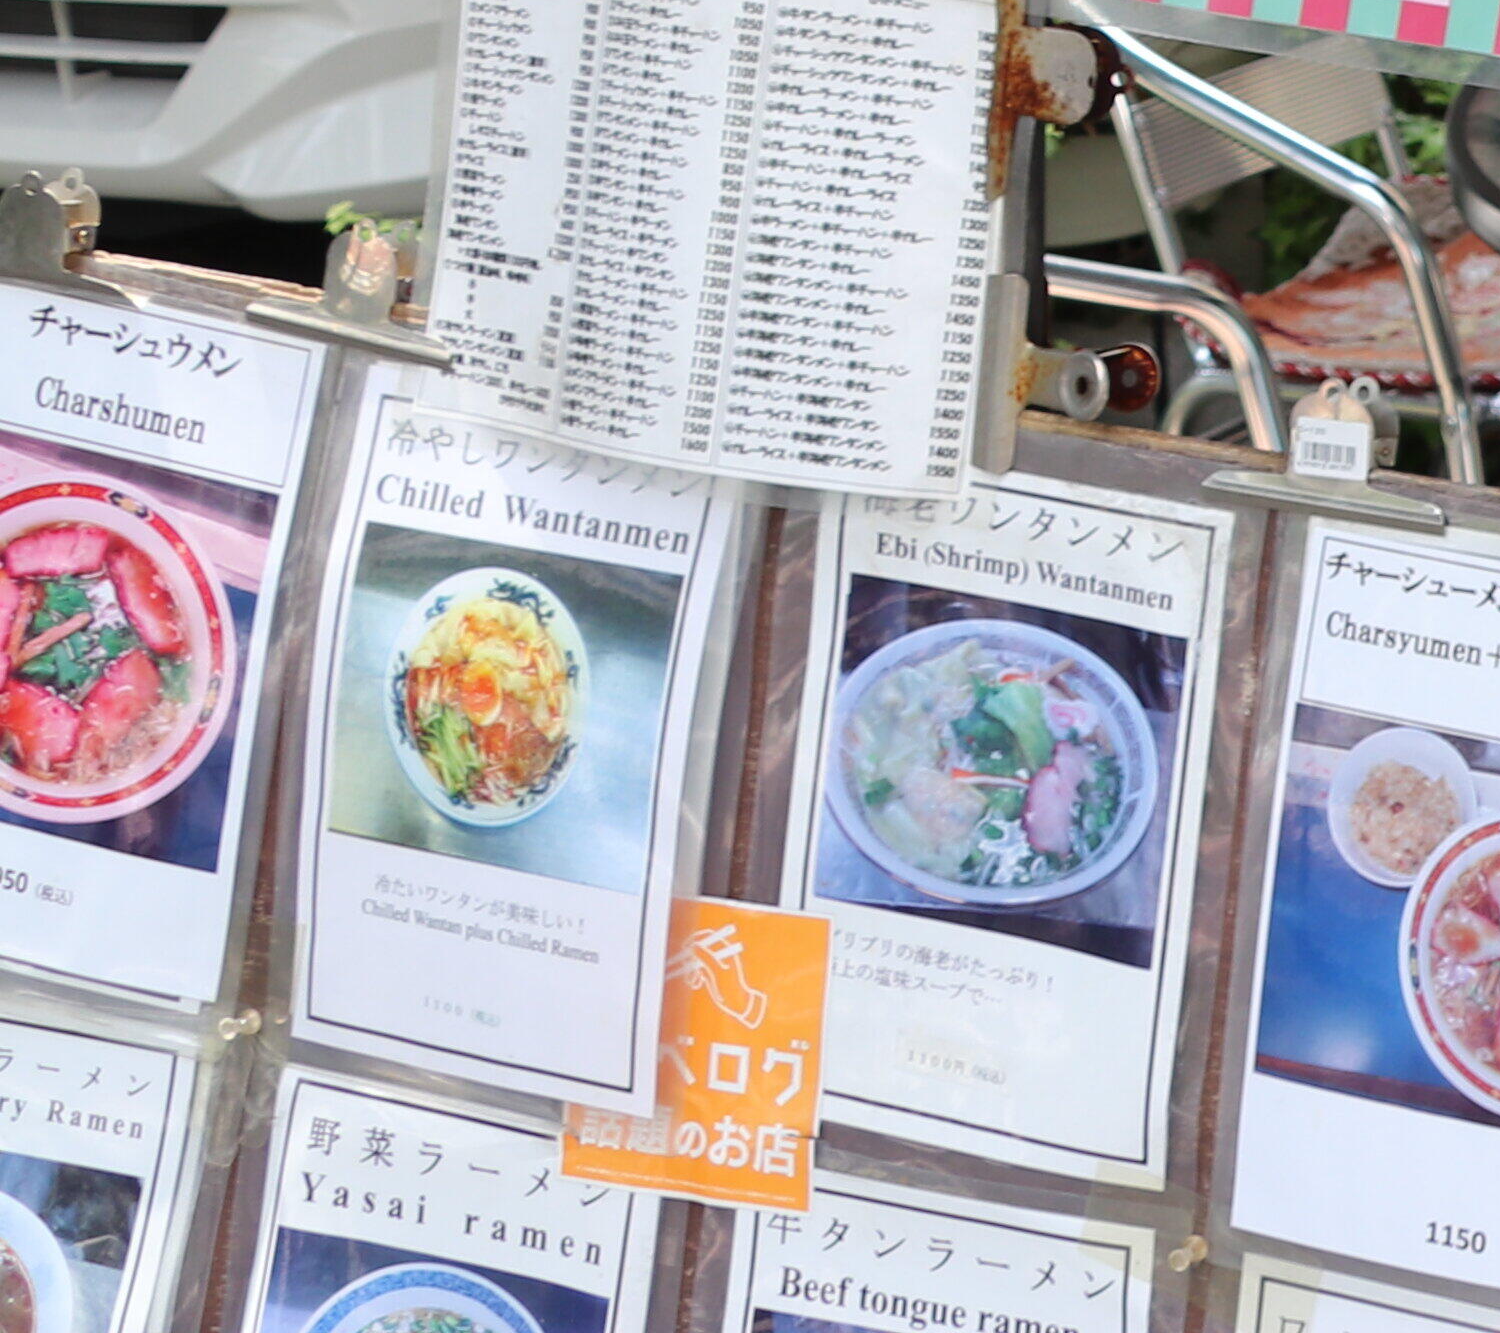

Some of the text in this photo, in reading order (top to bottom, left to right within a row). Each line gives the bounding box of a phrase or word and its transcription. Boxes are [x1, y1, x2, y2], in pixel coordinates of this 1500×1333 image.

[30, 304, 244, 378] チャーシュウメン
[35, 375, 207, 445] Charshumen
[376, 473, 690, 555] Chilled Wantanmen
[875, 531, 1174, 611] Ebi (Shrimp) Wantanmen
[0, 866, 28, 893] 50
[361, 897, 411, 925] Chilled
[465, 920, 494, 944] plus
[498, 927, 547, 954] Chilled
[551, 938, 599, 965] Ramen
[833, 928, 1056, 994] リプリの海老がたっぷり！
[46, 1098, 144, 1140] Ramen
[300, 1170, 603, 1267] Yasai ramen
[1424, 1220, 1488, 1255] 1150
[766, 1212, 1115, 1300] 牛タンラーメン
[780, 1265, 854, 1307] Beef
[859, 1280, 967, 1330] tongue
